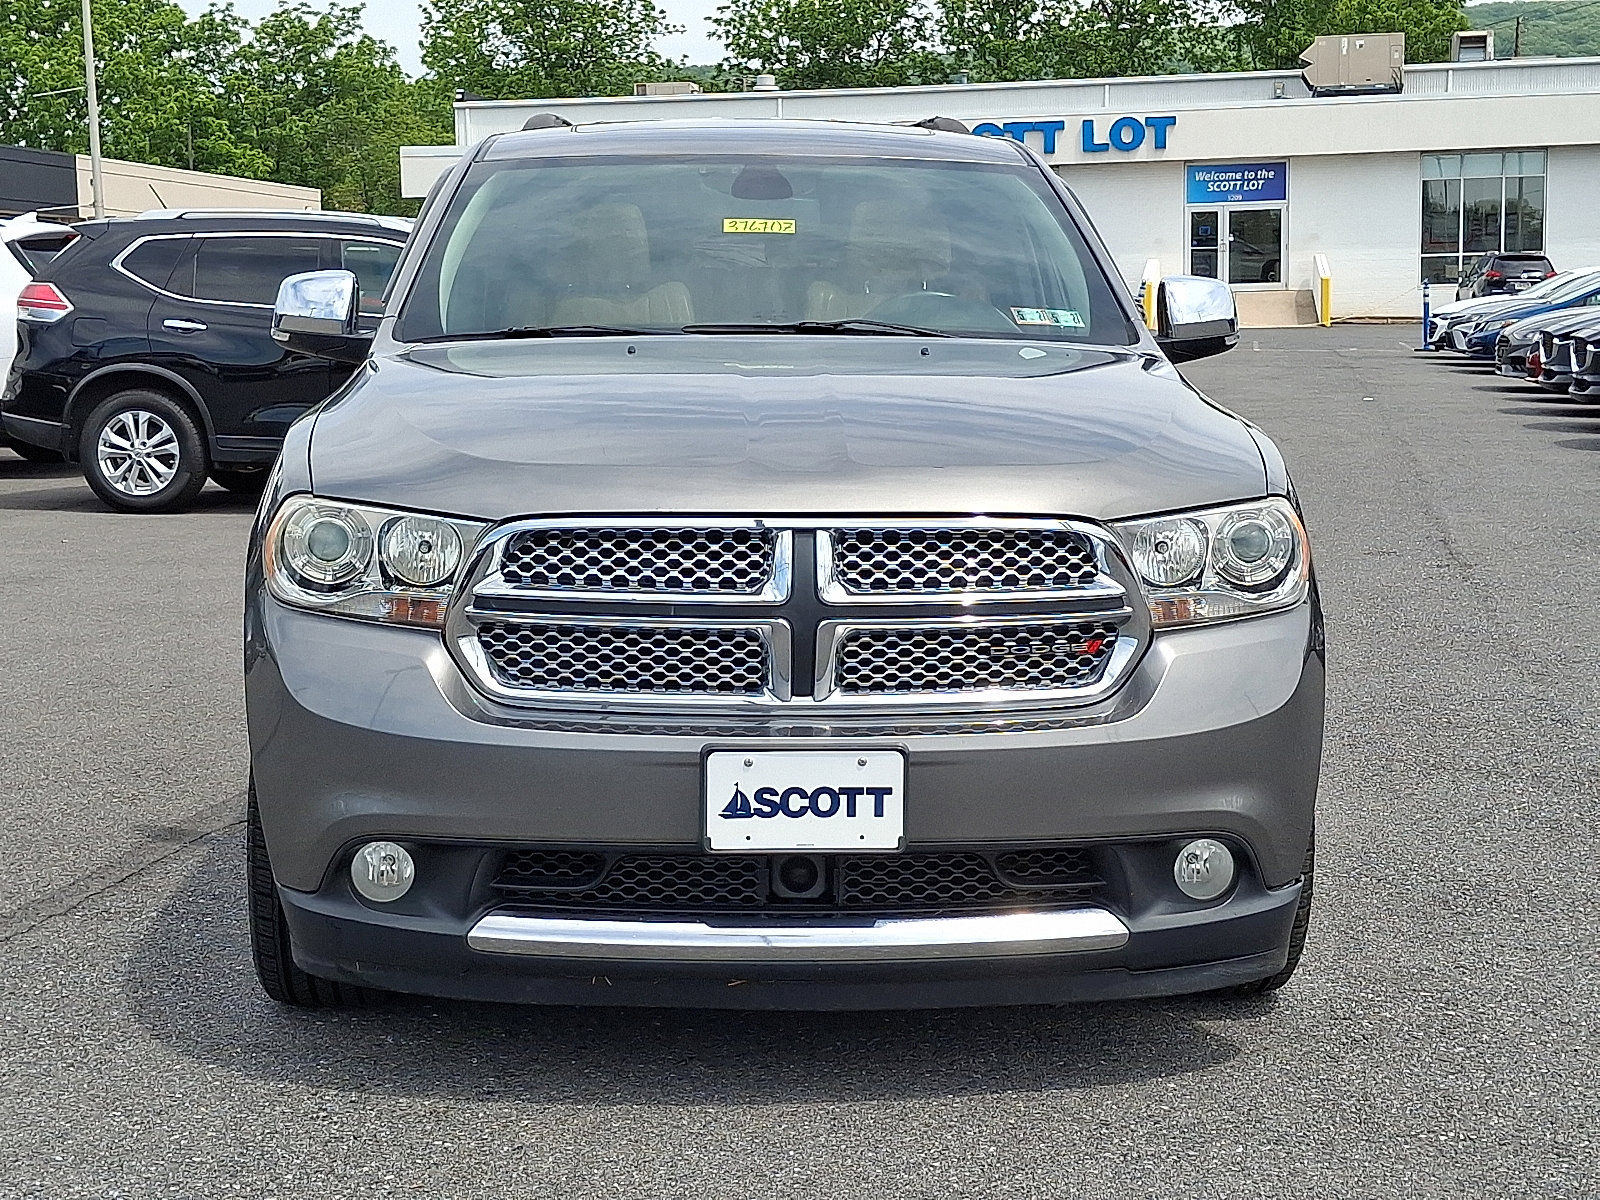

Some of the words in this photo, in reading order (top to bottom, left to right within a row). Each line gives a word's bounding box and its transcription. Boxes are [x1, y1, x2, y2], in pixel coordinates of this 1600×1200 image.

[1082, 116, 1177, 153] LOT
[1195, 171, 1242, 181] Welcome
[1243, 170, 1256, 180] to
[1257, 168, 1275, 179] the
[1206, 180, 1243, 192] SCOTT
[1243, 179, 1265, 191] LOT
[990, 643, 1089, 655] DODGE
[753, 786, 893, 819] SCOTT
